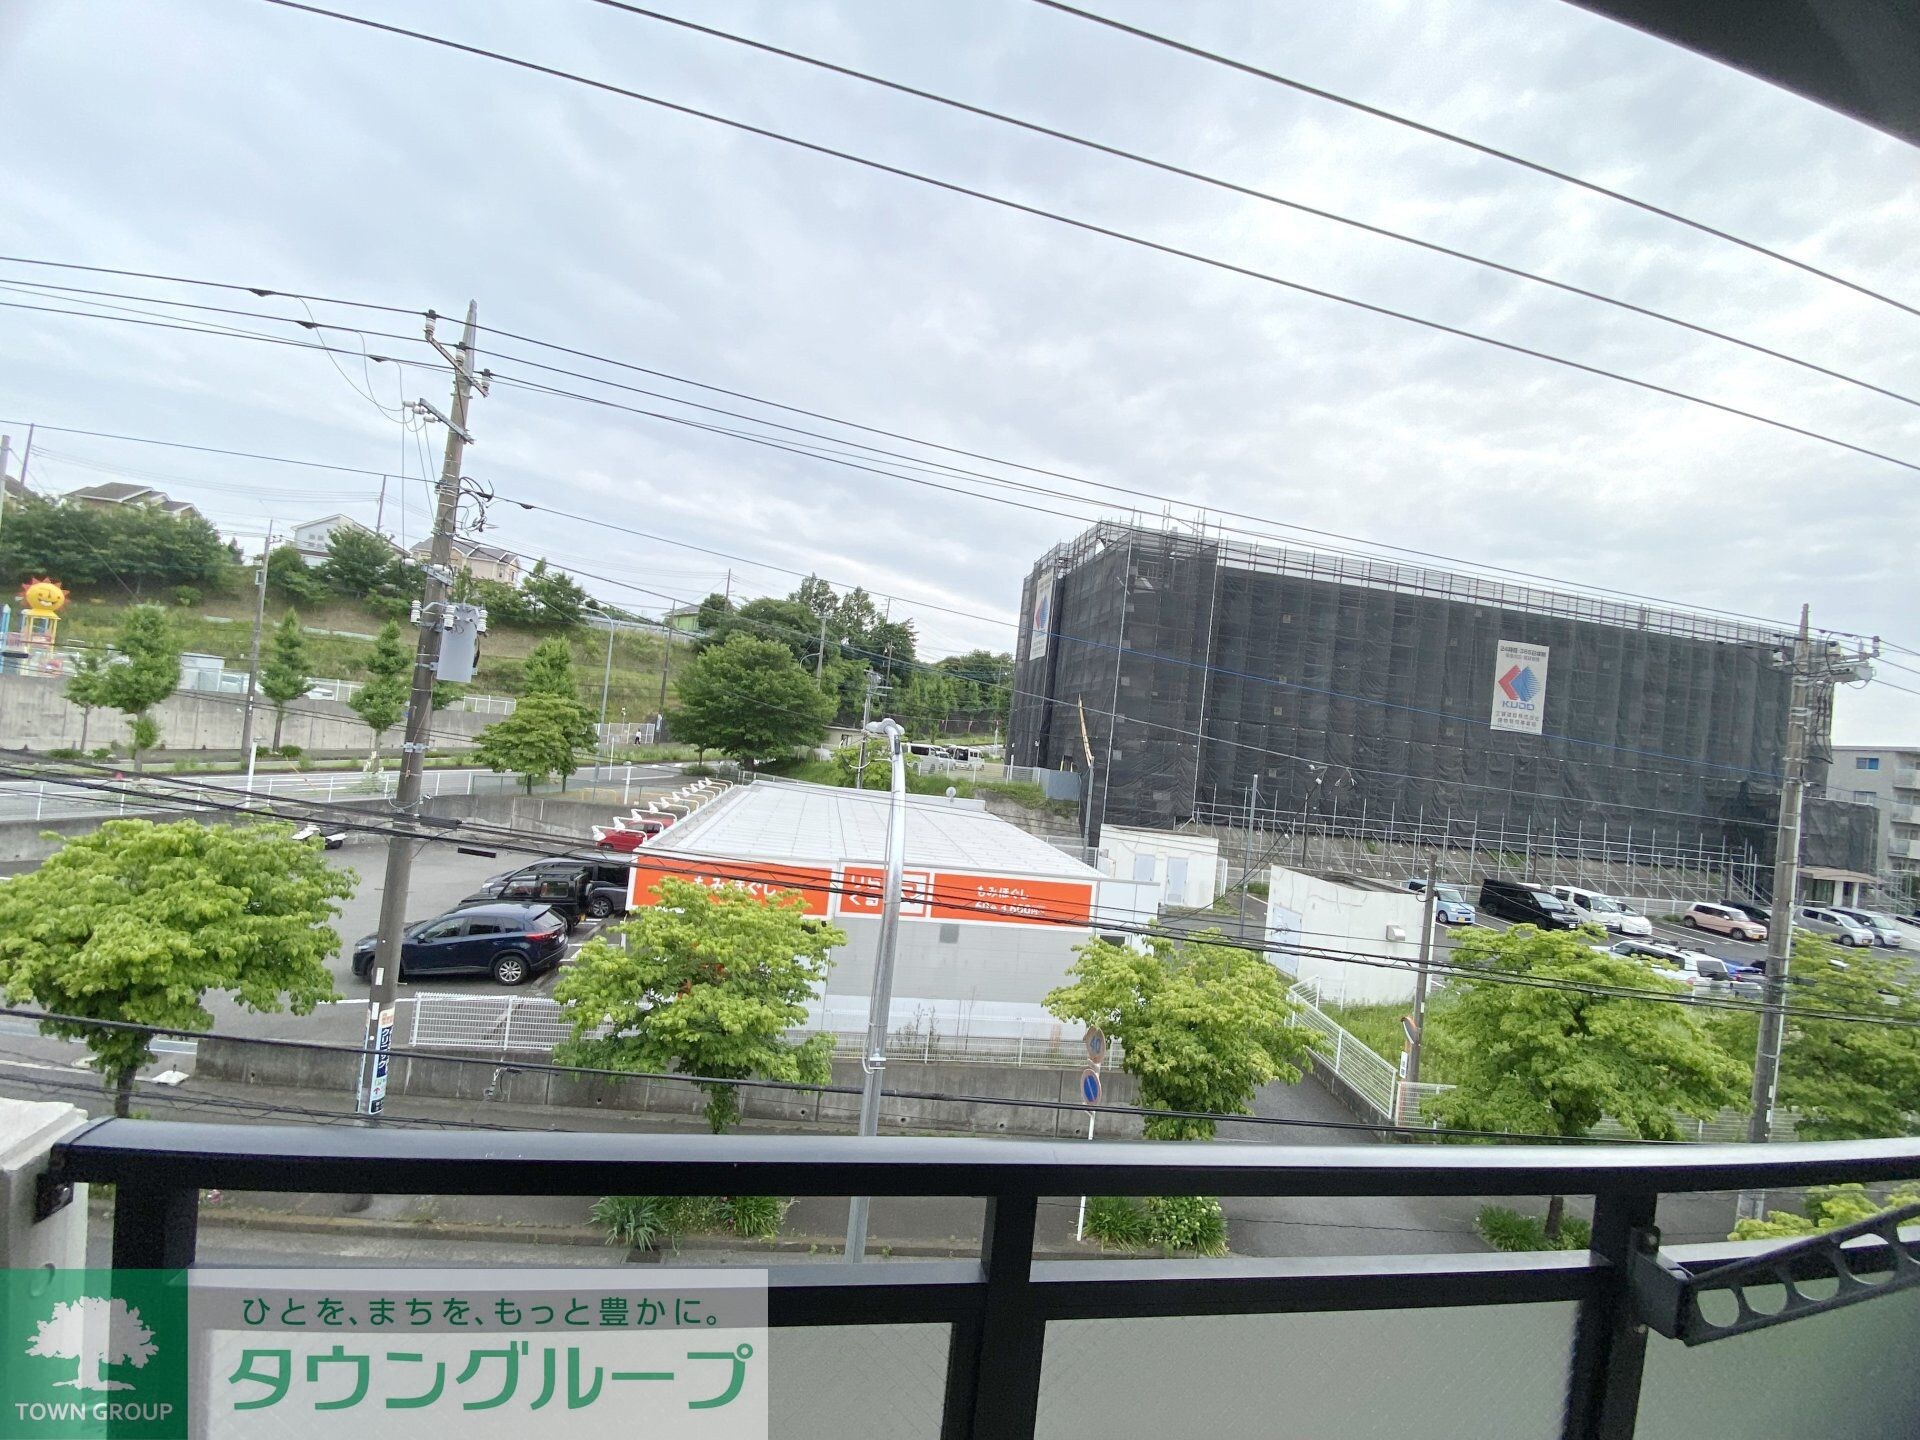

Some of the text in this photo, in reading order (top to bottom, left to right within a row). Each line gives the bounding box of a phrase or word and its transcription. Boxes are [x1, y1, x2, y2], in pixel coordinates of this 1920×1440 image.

[977, 885, 1029, 900] もみほぐし
